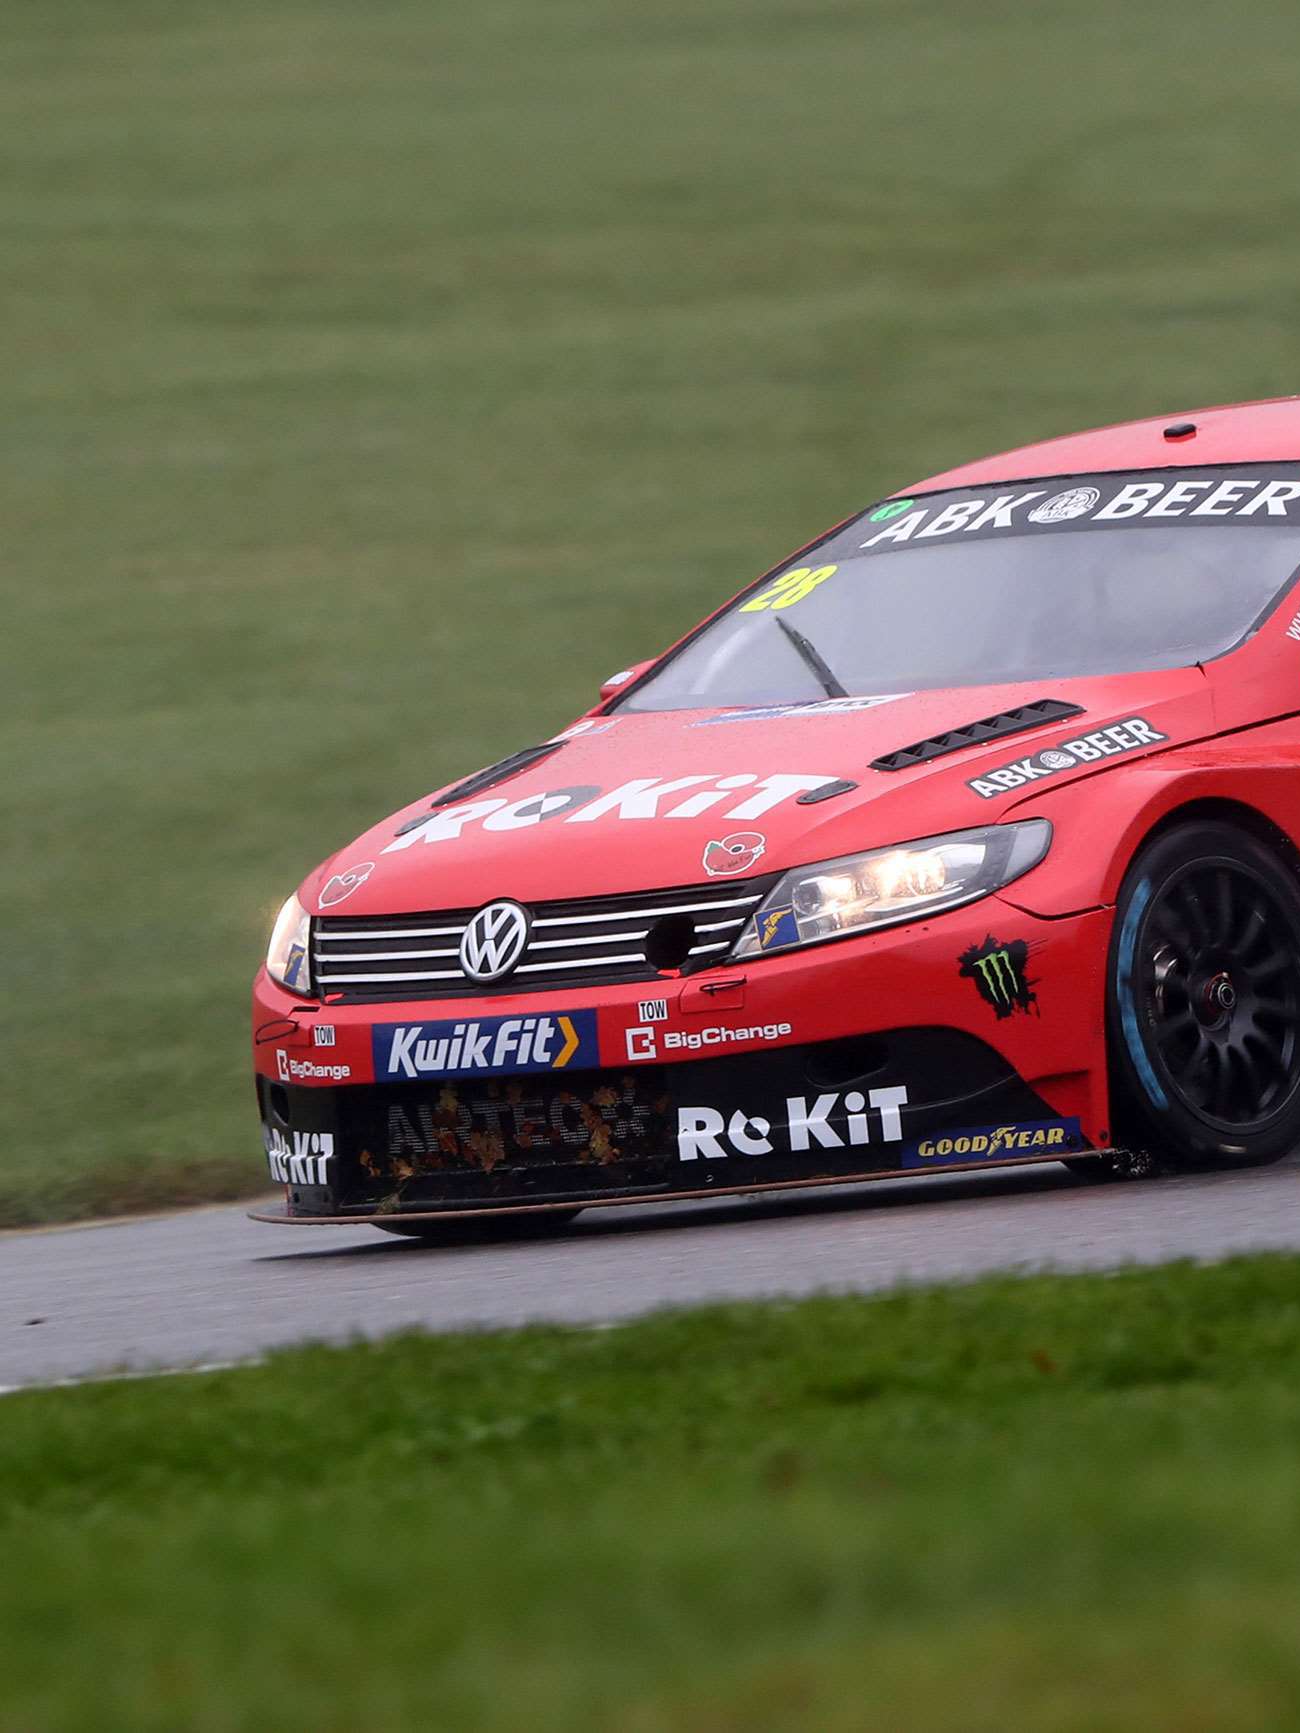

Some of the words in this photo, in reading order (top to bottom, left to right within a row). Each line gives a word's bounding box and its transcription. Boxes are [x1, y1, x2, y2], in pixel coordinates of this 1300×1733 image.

[860, 491, 1048, 549] ABK
[739, 565, 838, 612] 28
[969, 759, 1053, 798] ABK
[1063, 719, 1166, 762] BEER
[639, 1000, 666, 1020] TOW
[315, 1026, 335, 1046] TOW
[664, 1023, 792, 1049] BigChange
[290, 1060, 350, 1079] BigChange
